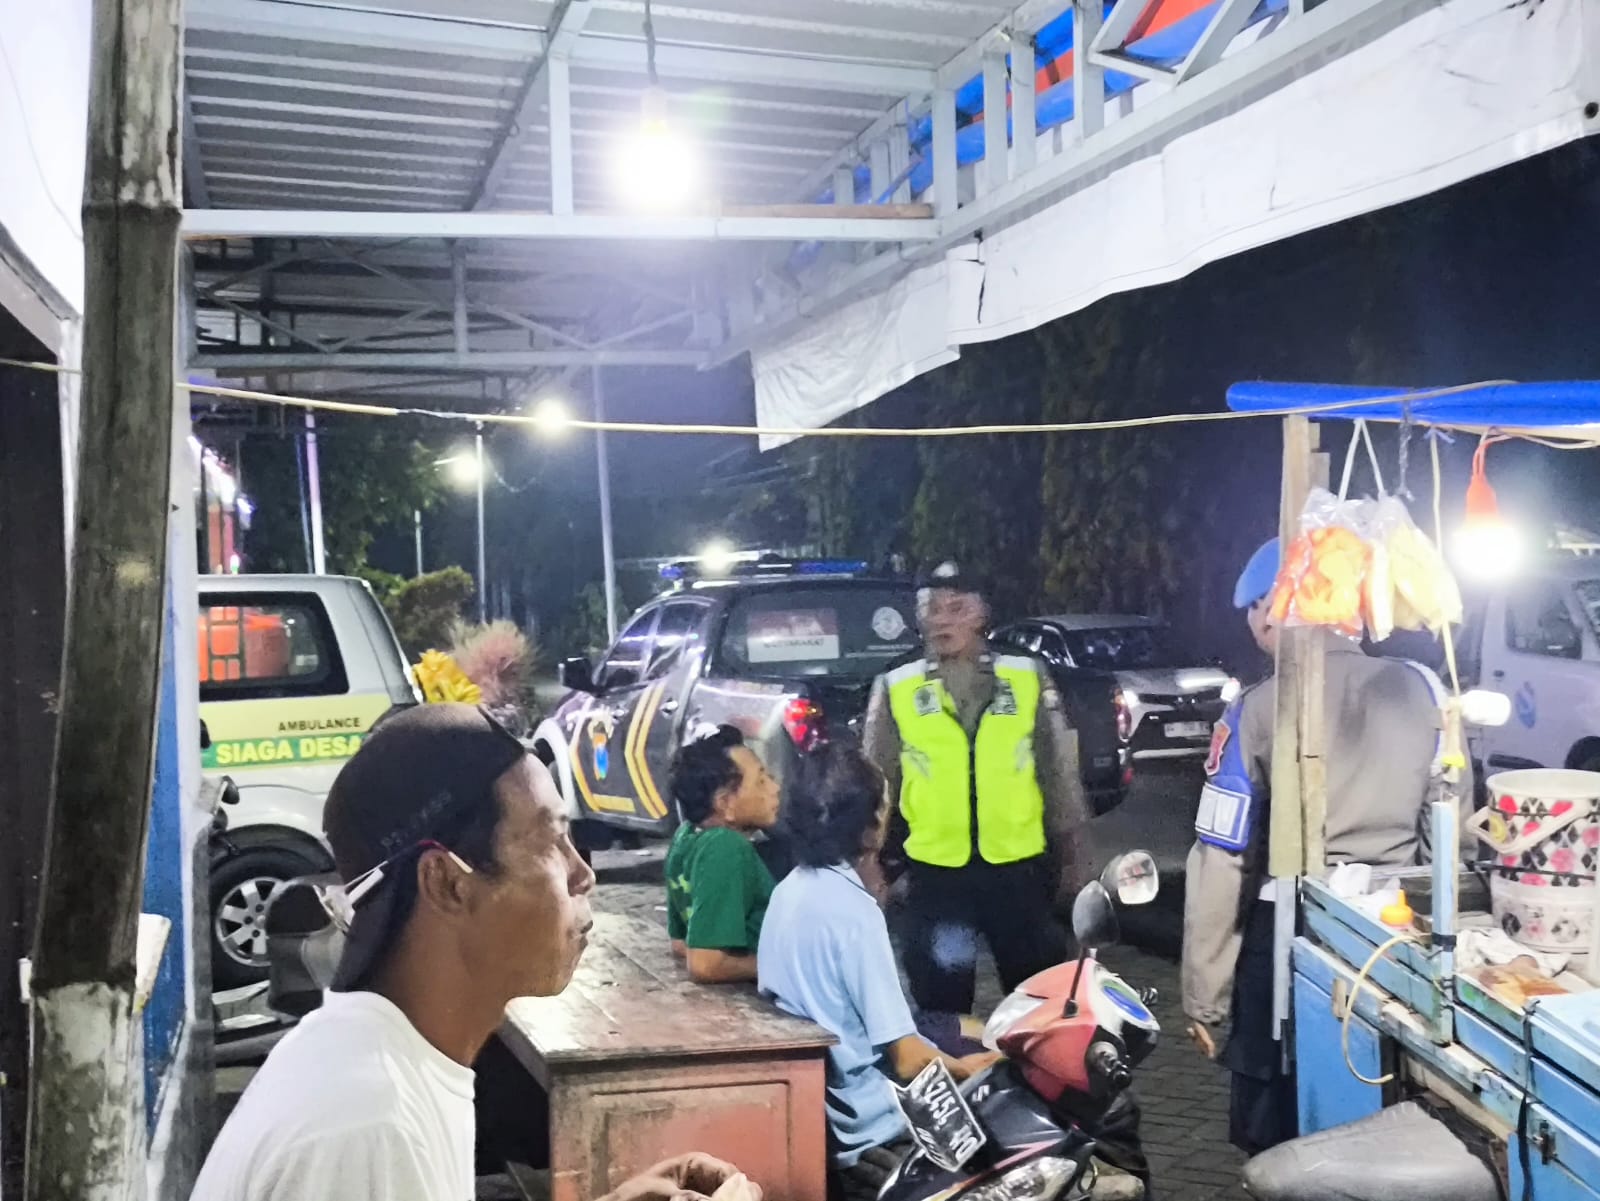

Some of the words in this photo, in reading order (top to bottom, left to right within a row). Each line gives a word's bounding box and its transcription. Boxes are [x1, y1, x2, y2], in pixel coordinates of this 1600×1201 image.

[278, 717, 361, 732] AMBULANCE
[215, 739, 295, 764] SIAGA
[300, 735, 363, 759] DESA
